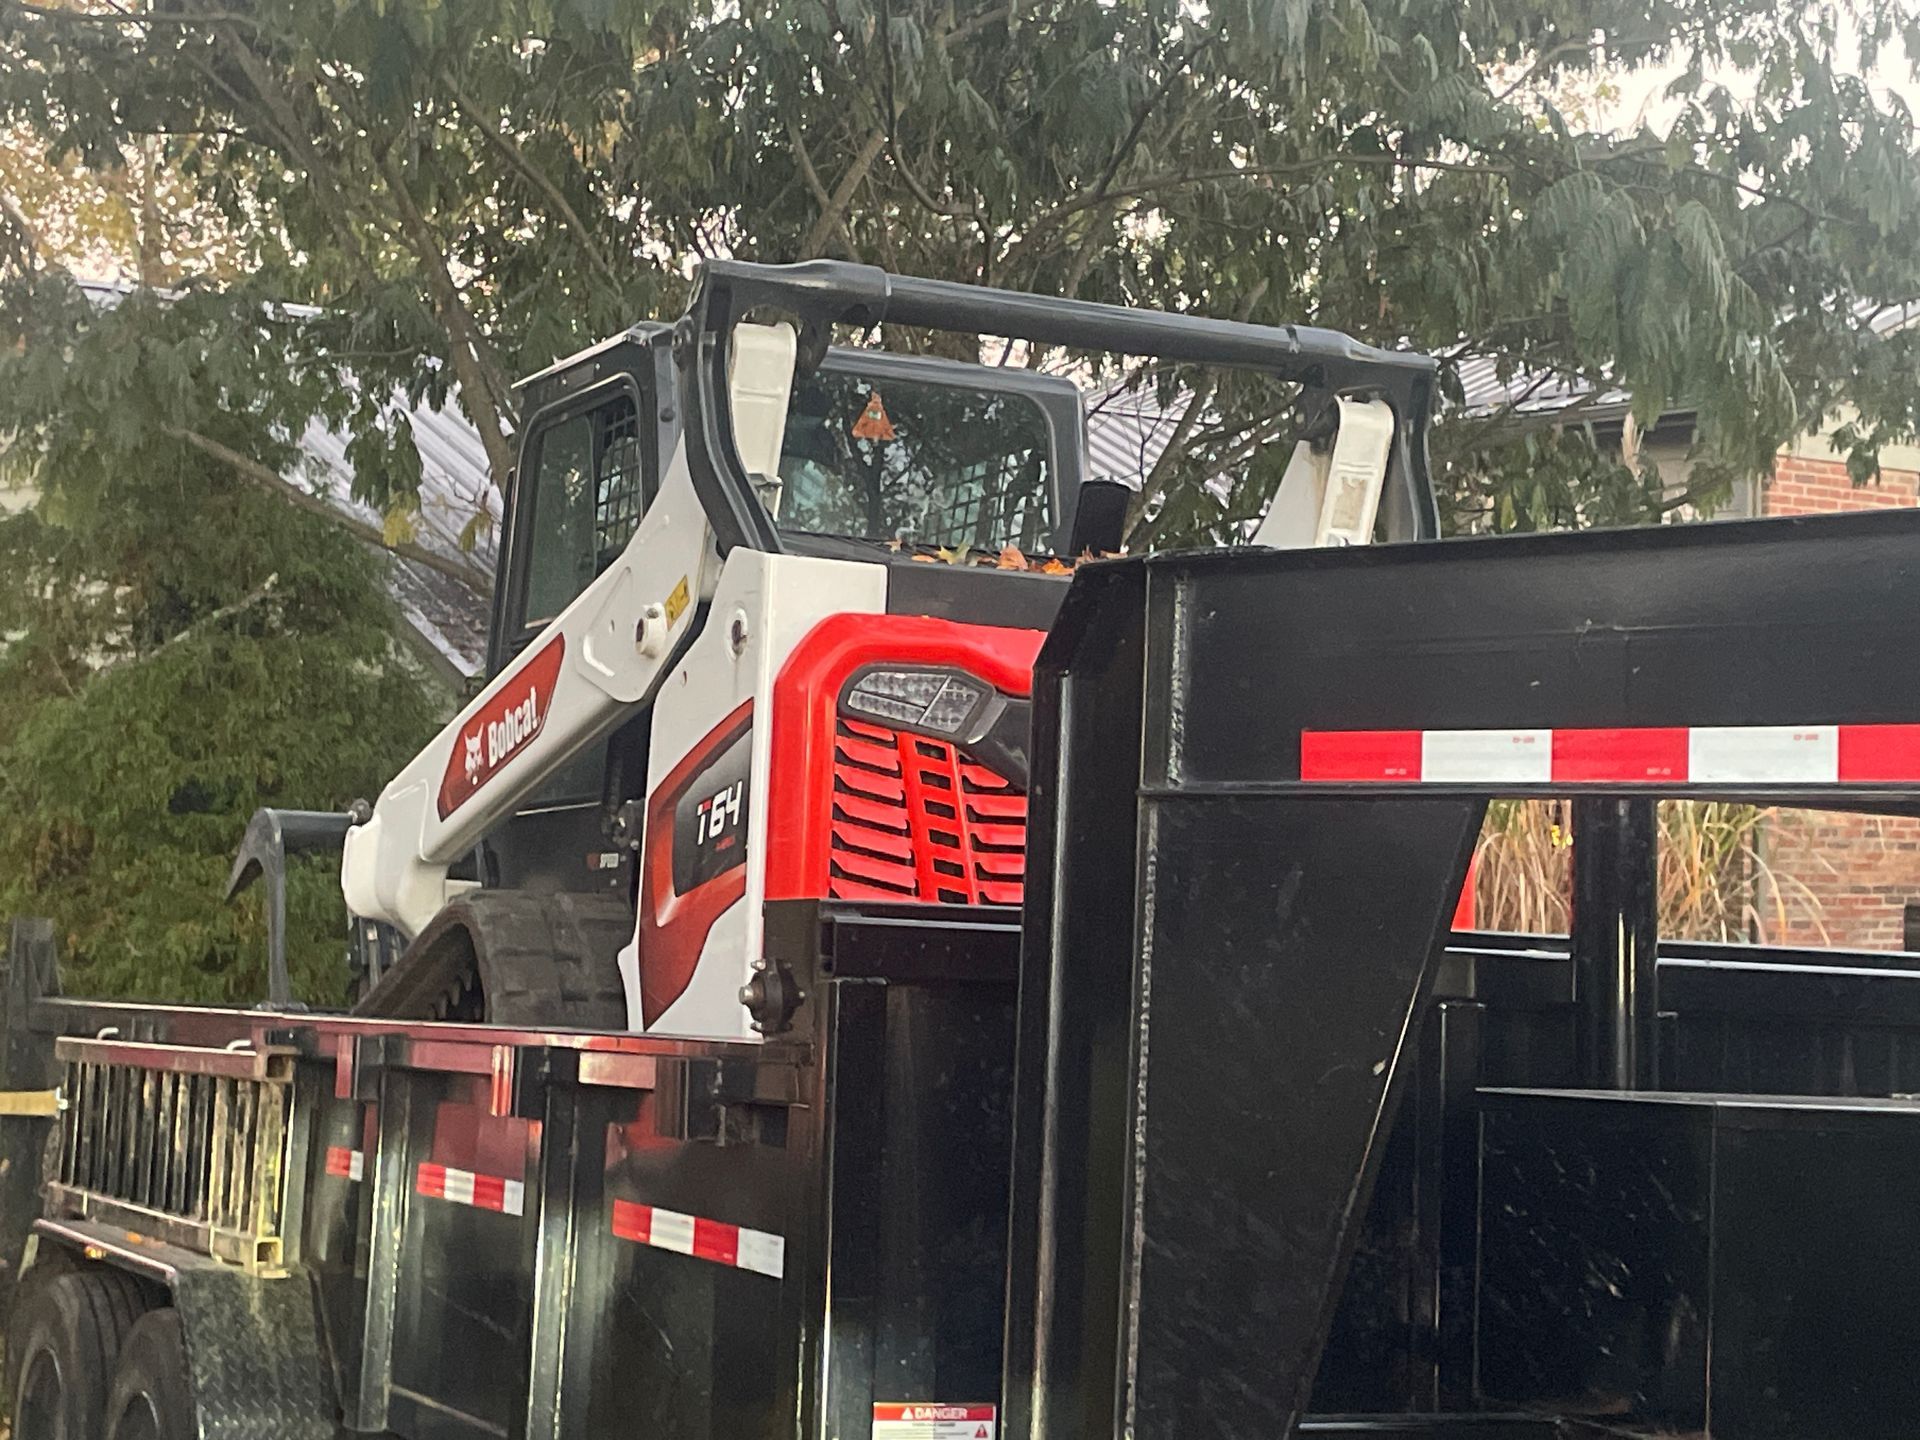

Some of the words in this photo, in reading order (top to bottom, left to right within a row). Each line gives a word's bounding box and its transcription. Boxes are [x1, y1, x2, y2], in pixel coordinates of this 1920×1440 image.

[488, 686, 538, 768] Bobcat
[697, 781, 743, 845] T64
[914, 1407, 968, 1419] DANGER
